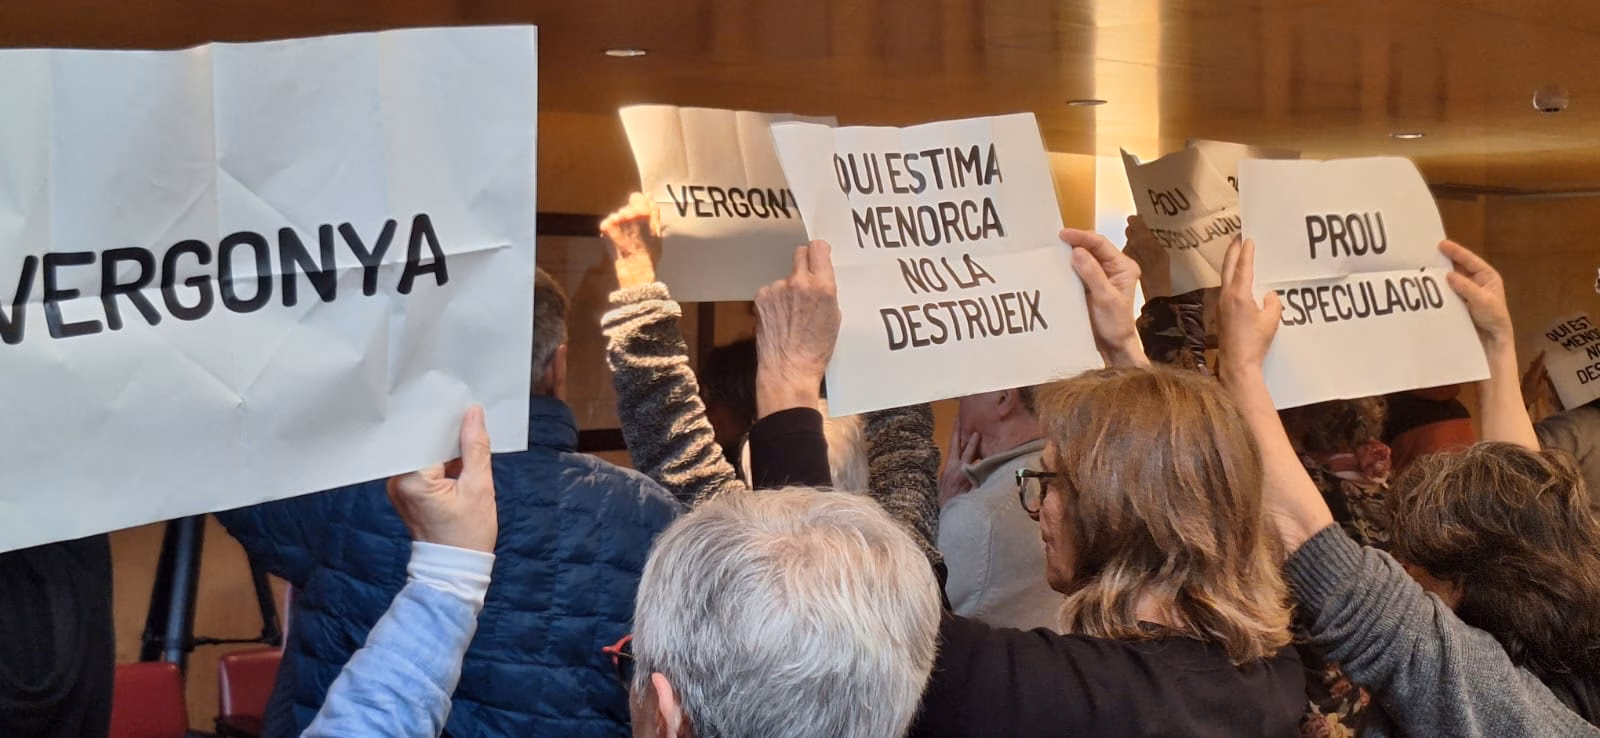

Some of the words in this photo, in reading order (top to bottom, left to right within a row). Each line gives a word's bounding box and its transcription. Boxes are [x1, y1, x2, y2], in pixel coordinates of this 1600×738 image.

[833, 152, 884, 199] QUI
[885, 142, 1003, 195] ESTIMA
[852, 197, 1006, 249] MENORCA
[1305, 211, 1388, 260] PROU
[0, 213, 448, 345] VERGONYA
[897, 257, 945, 295] NO
[941, 252, 996, 289] LA
[880, 290, 1049, 351] DESTRUEIX
